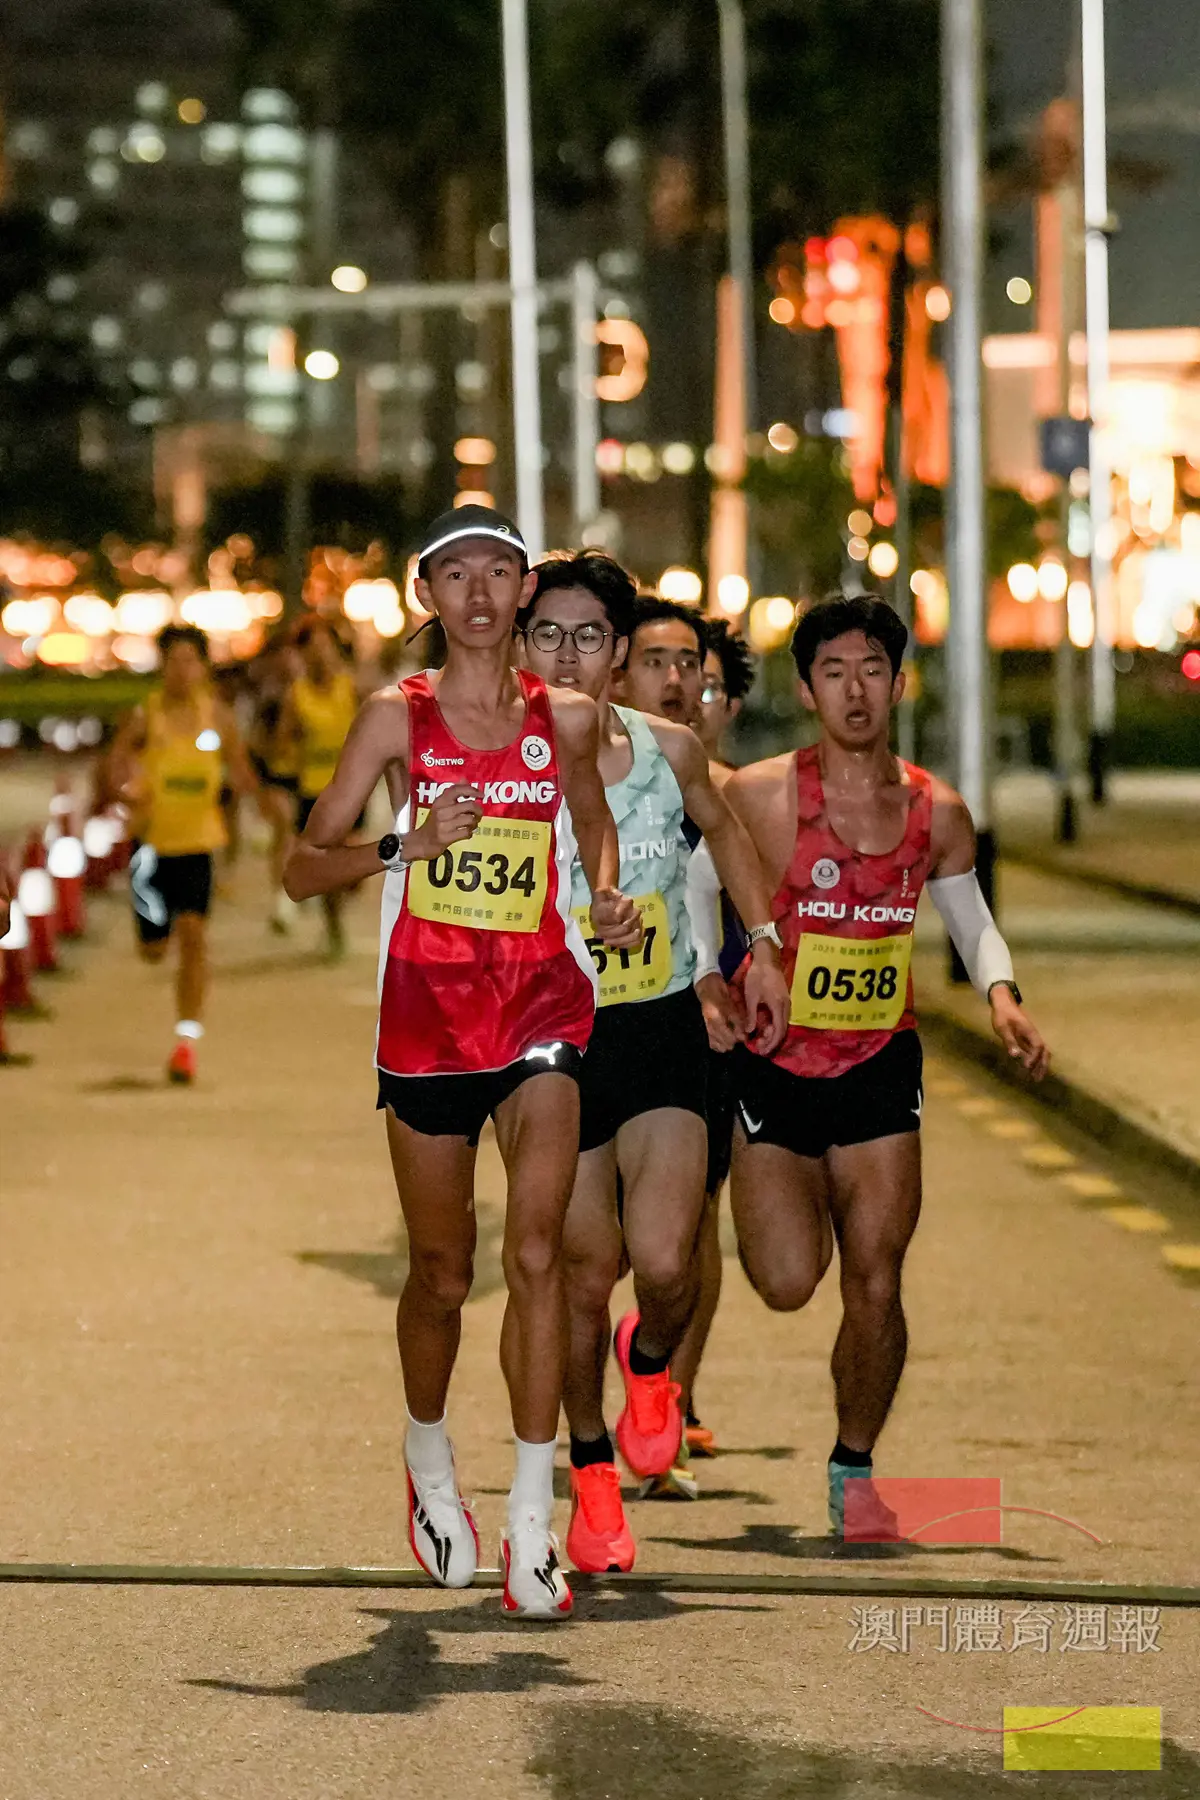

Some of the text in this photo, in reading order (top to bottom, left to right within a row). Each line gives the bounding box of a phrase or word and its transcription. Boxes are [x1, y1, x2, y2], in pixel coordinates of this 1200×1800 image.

[482, 781, 557, 804] KONG
[427, 848, 536, 898] 0534
[798, 901, 915, 923] HOU KONG
[807, 966, 897, 1002] 0538
